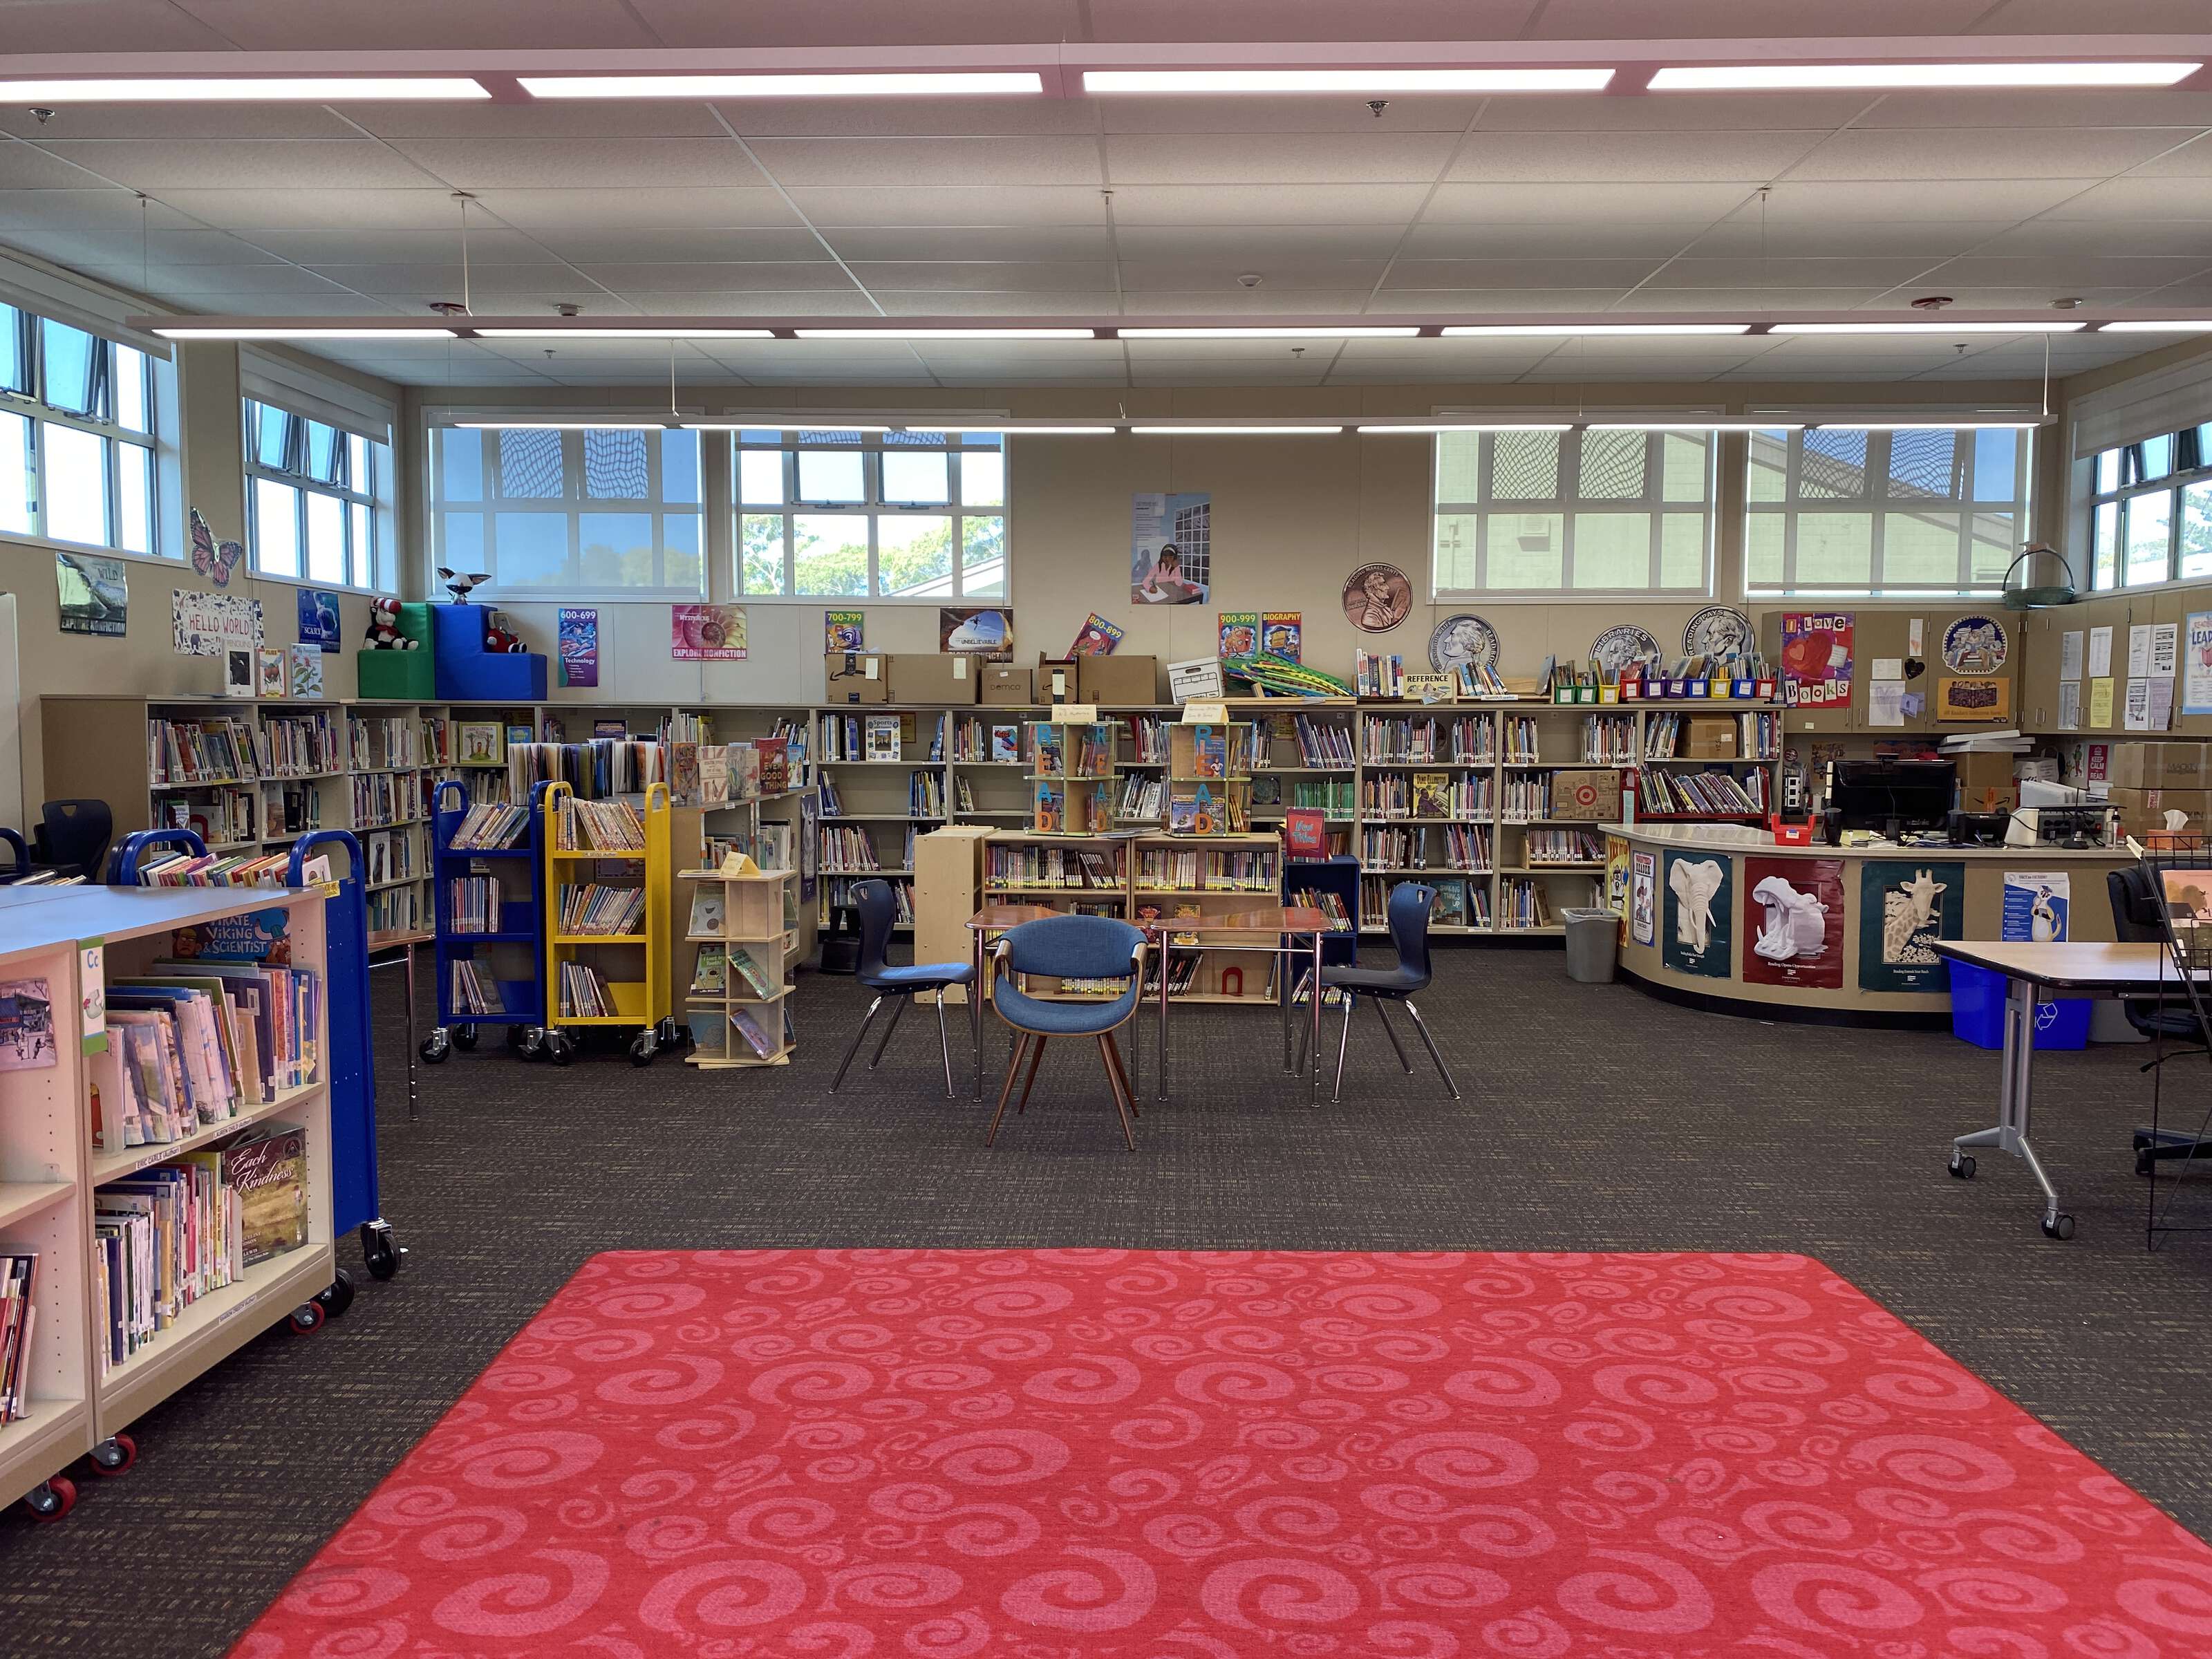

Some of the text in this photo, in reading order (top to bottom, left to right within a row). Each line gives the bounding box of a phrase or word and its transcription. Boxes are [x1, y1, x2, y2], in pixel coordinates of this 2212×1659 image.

[98, 568, 118, 580] WILD
[1347, 570, 1366, 588] READING
[1384, 566, 1399, 577] CENTS
[561, 611, 596, 619] 600-699
[828, 613, 862, 621] 700-799
[1220, 615, 1256, 623] 900-999
[1263, 612, 1301, 621] BIOGRAPHY
[61, 619, 125, 632] EXPLORE NONFICTION
[189, 614, 250, 635] HELLO WORLD
[304, 626, 321, 635] SCARY
[1089, 615, 1122, 639] 800-899
[1485, 629, 1497, 649] READ
[1687, 610, 1724, 656] READING PAYS
[1595, 628, 1648, 653] LIBRARIES
[673, 649, 747, 658] EXPLORE NONFICTION
[765, 762, 787, 770] EVERY
[765, 781, 787, 789] THING
[1296, 820, 1313, 832] New
[87, 951, 99, 968] Cc
[232, 1141, 271, 1174] Each
[236, 1161, 294, 1194] Kindness
